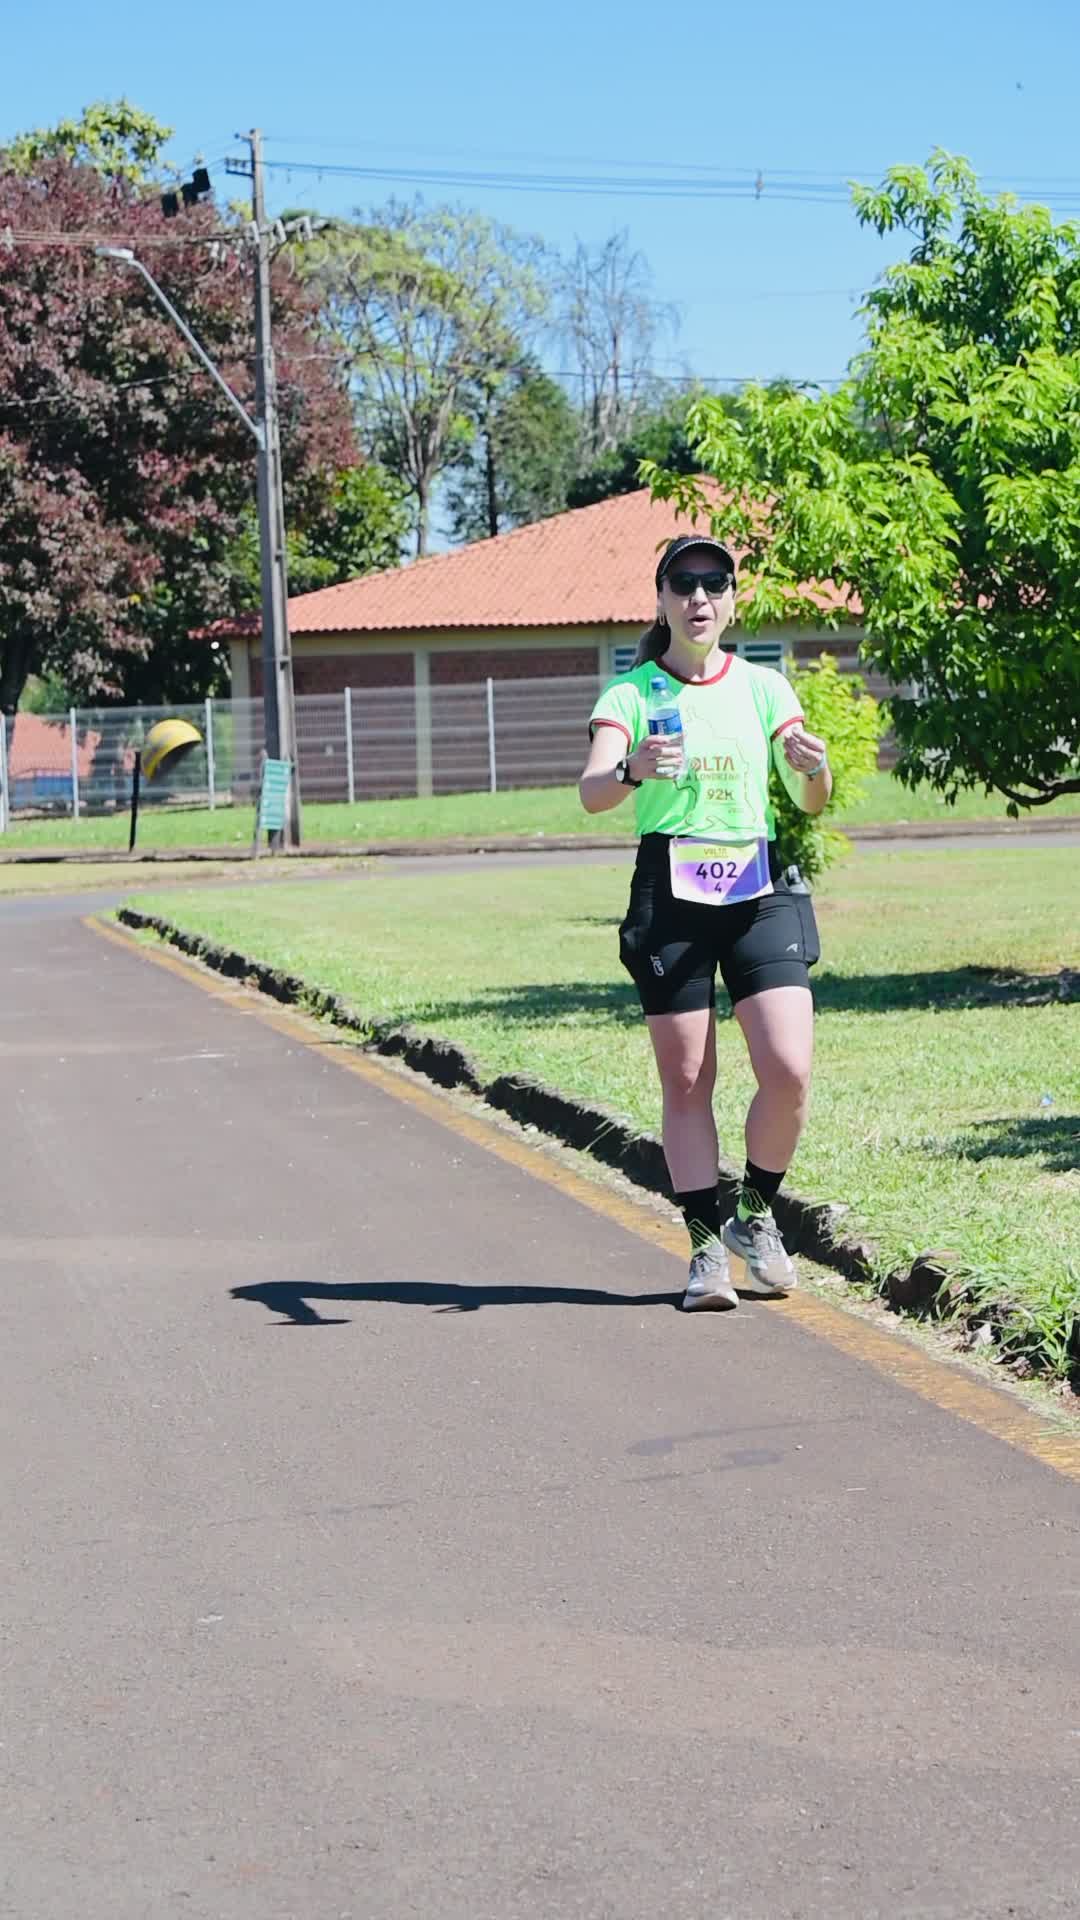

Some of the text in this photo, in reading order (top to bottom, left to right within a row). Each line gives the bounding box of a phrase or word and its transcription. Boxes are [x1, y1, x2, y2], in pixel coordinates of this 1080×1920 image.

[688, 756, 735, 771] OLTA
[707, 788, 734, 801] 92K
[696, 862, 737, 879] 402
[714, 881, 722, 893] 4
